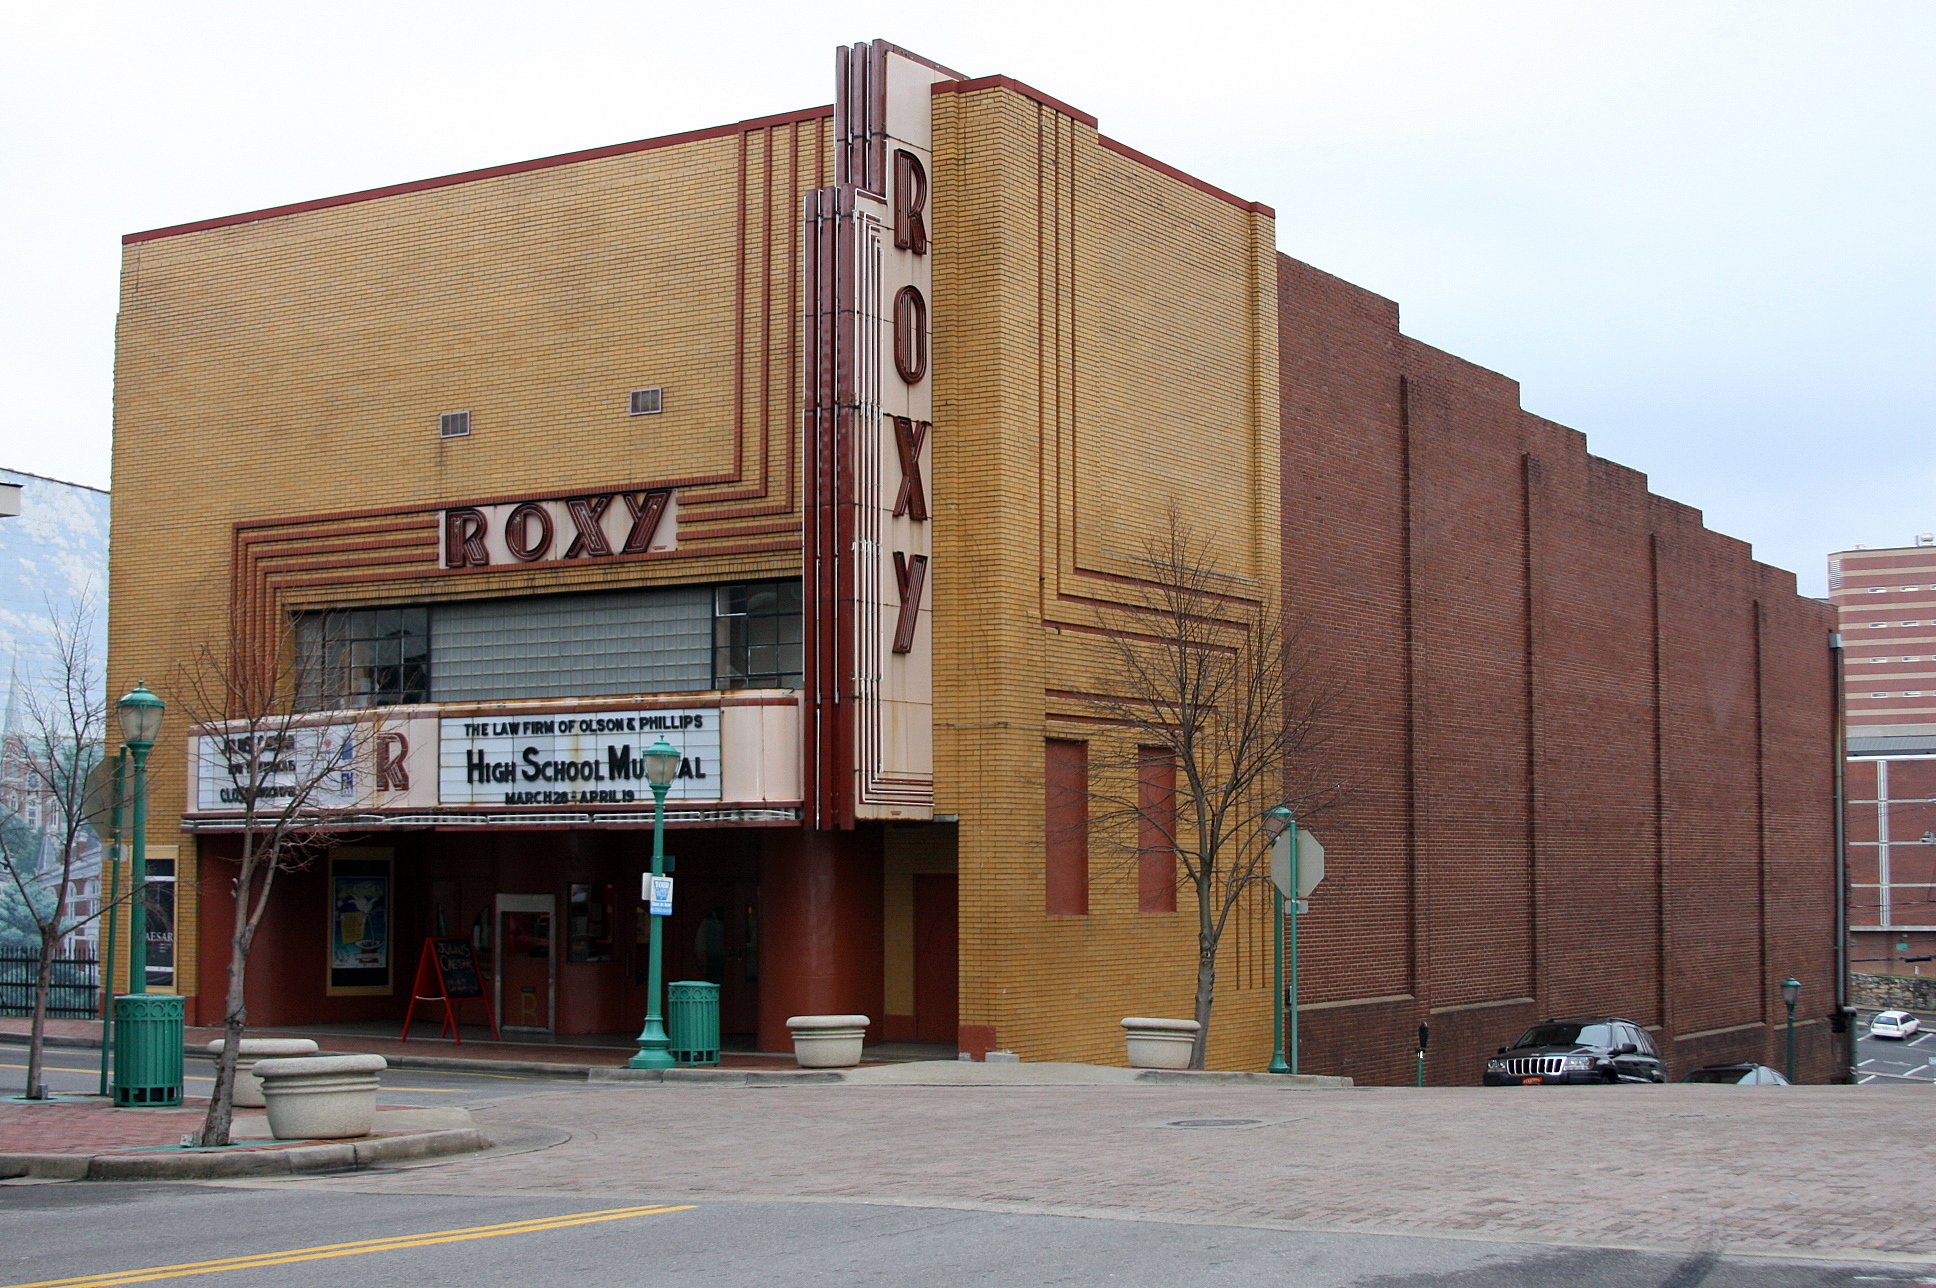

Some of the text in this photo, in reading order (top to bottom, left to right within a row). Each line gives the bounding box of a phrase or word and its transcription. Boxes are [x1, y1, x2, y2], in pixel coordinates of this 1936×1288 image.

[893, 148, 927, 653] ROXY
[445, 488, 671, 567] ROXY
[465, 714, 703, 737] THE LAW FIRM OF OLSON & PHILLIPS
[376, 732, 410, 791] R
[466, 744, 706, 784] HIGH SCHOOL MUAL
[505, 790, 551, 805] MARCH
[579, 789, 620, 804] APRIL
[622, 789, 635, 803] 19
[145, 931, 173, 942] AESAR
